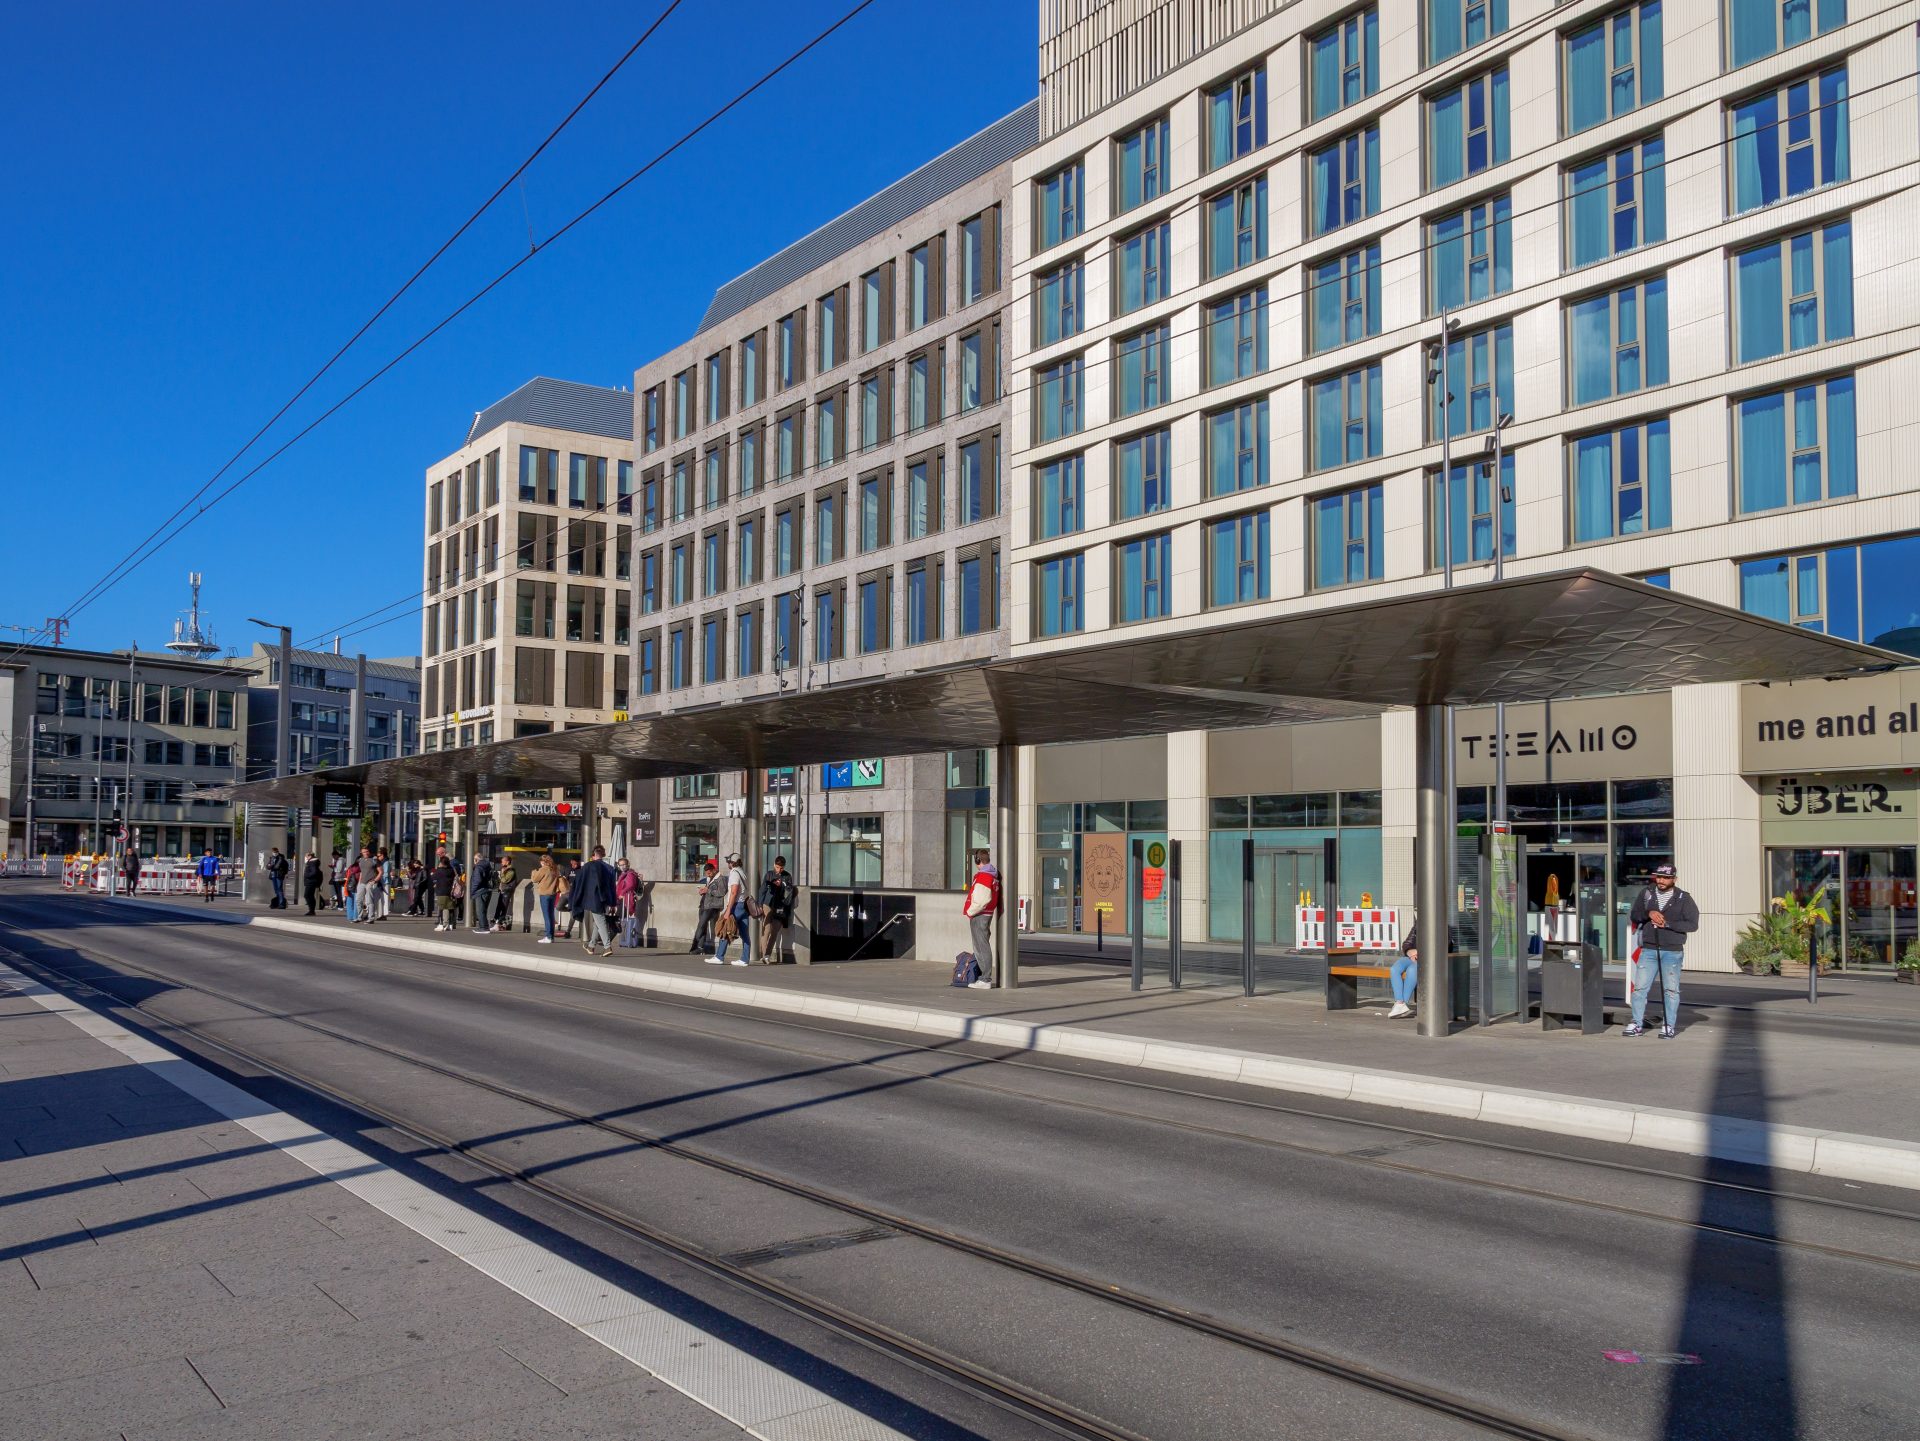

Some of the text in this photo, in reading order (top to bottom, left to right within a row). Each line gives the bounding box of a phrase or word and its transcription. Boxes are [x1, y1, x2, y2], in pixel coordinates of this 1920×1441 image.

[1758, 702, 1918, 742] me and al
[521, 801, 558, 815] SNACK
